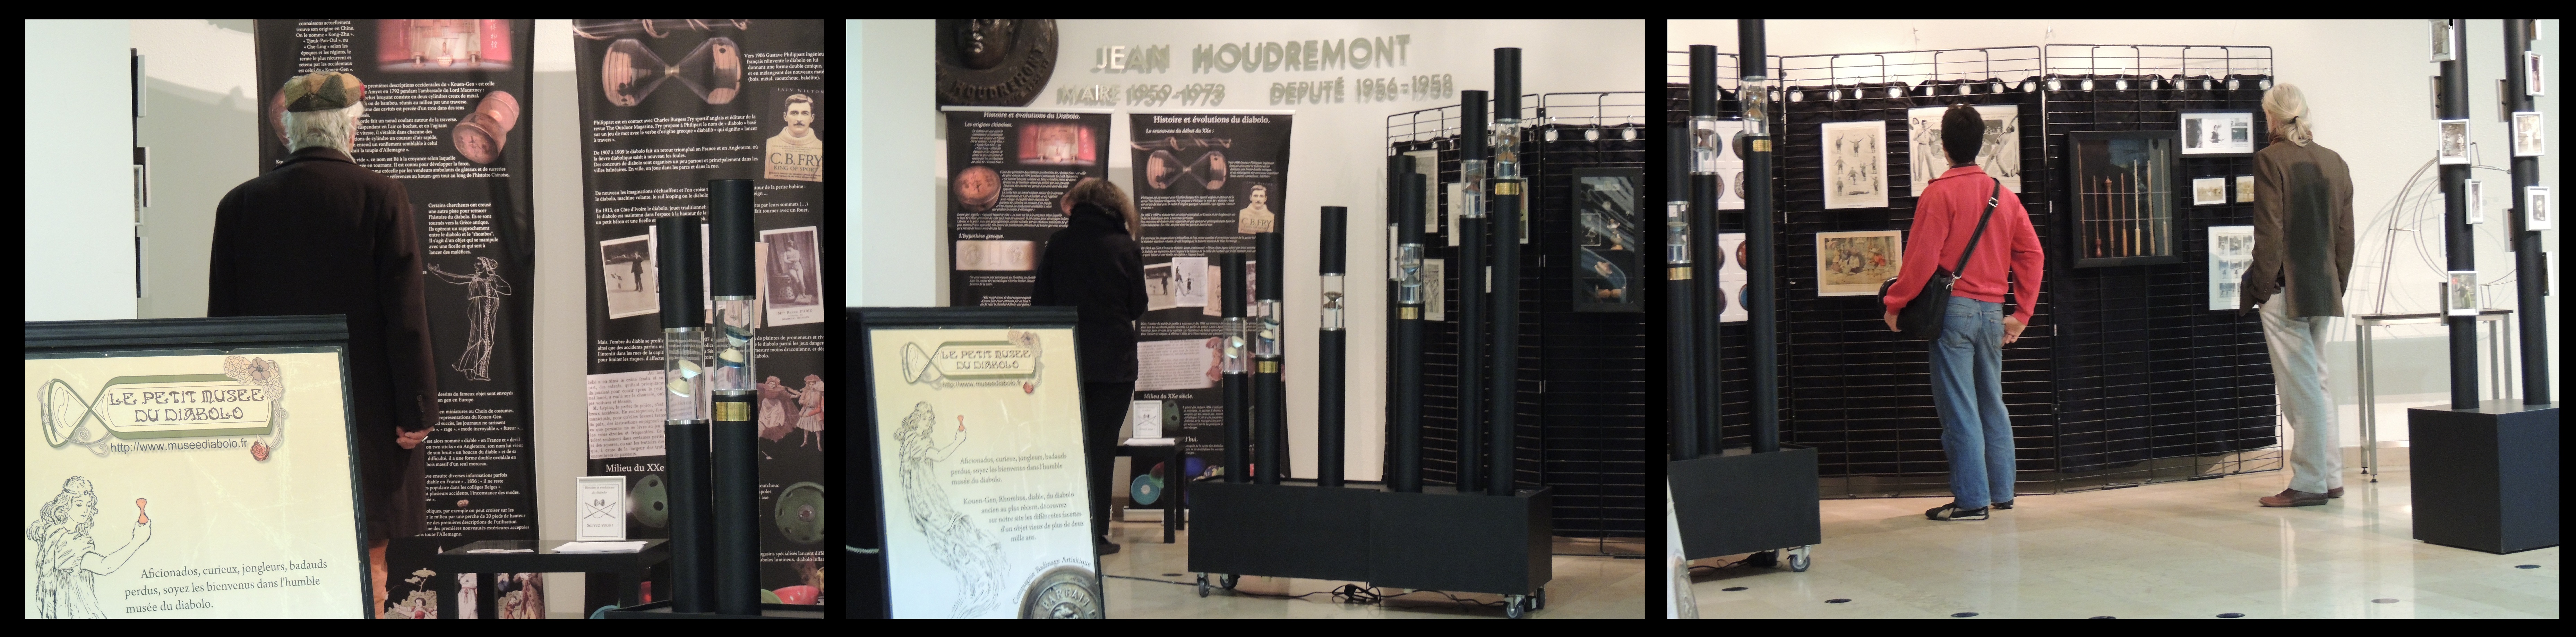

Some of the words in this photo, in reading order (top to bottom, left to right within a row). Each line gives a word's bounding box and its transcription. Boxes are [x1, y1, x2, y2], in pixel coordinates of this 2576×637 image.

[1097, 43, 1170, 70] JEAN
[1196, 34, 1410, 71] HOUDREMONT
[1060, 84, 1121, 103] MAIRE
[942, 350, 958, 359] LE
[961, 350, 991, 359] PETIT
[995, 350, 1030, 359] MUSEE
[956, 361, 971, 370] DU
[974, 360, 1019, 369] DIABOLO
[110, 393, 137, 405] LE
[142, 391, 196, 404] PETIT
[202, 389, 265, 404] MUSEE
[135, 409, 160, 422] DU
[165, 407, 243, 421] DIABOLO
[111, 438, 247, 454] http://www.museediabolo.fr
[606, 464, 632, 472] Milieu
[647, 463, 664, 472] XXe
[1008, 504, 1019, 513] plus
[1014, 524, 1028, 533] objet
[1052, 521, 1063, 530] plus
[140, 566, 200, 579] Aficionados,
[203, 565, 240, 575] curieux,
[242, 562, 287, 576] jongleurs,
[289, 559, 327, 570] badauds
[1035, 559, 1060, 573] Badinage
[124, 585, 161, 600] perdus,
[163, 586, 189, 596] soyez
[191, 582, 204, 592] les
[206, 580, 254, 591] bienvenus
[257, 578, 278, 588] dans
[280, 576, 320, 587] l'humble
[126, 603, 157, 613] musée
[160, 601, 173, 611] du
[175, 598, 213, 610] diabolo.
